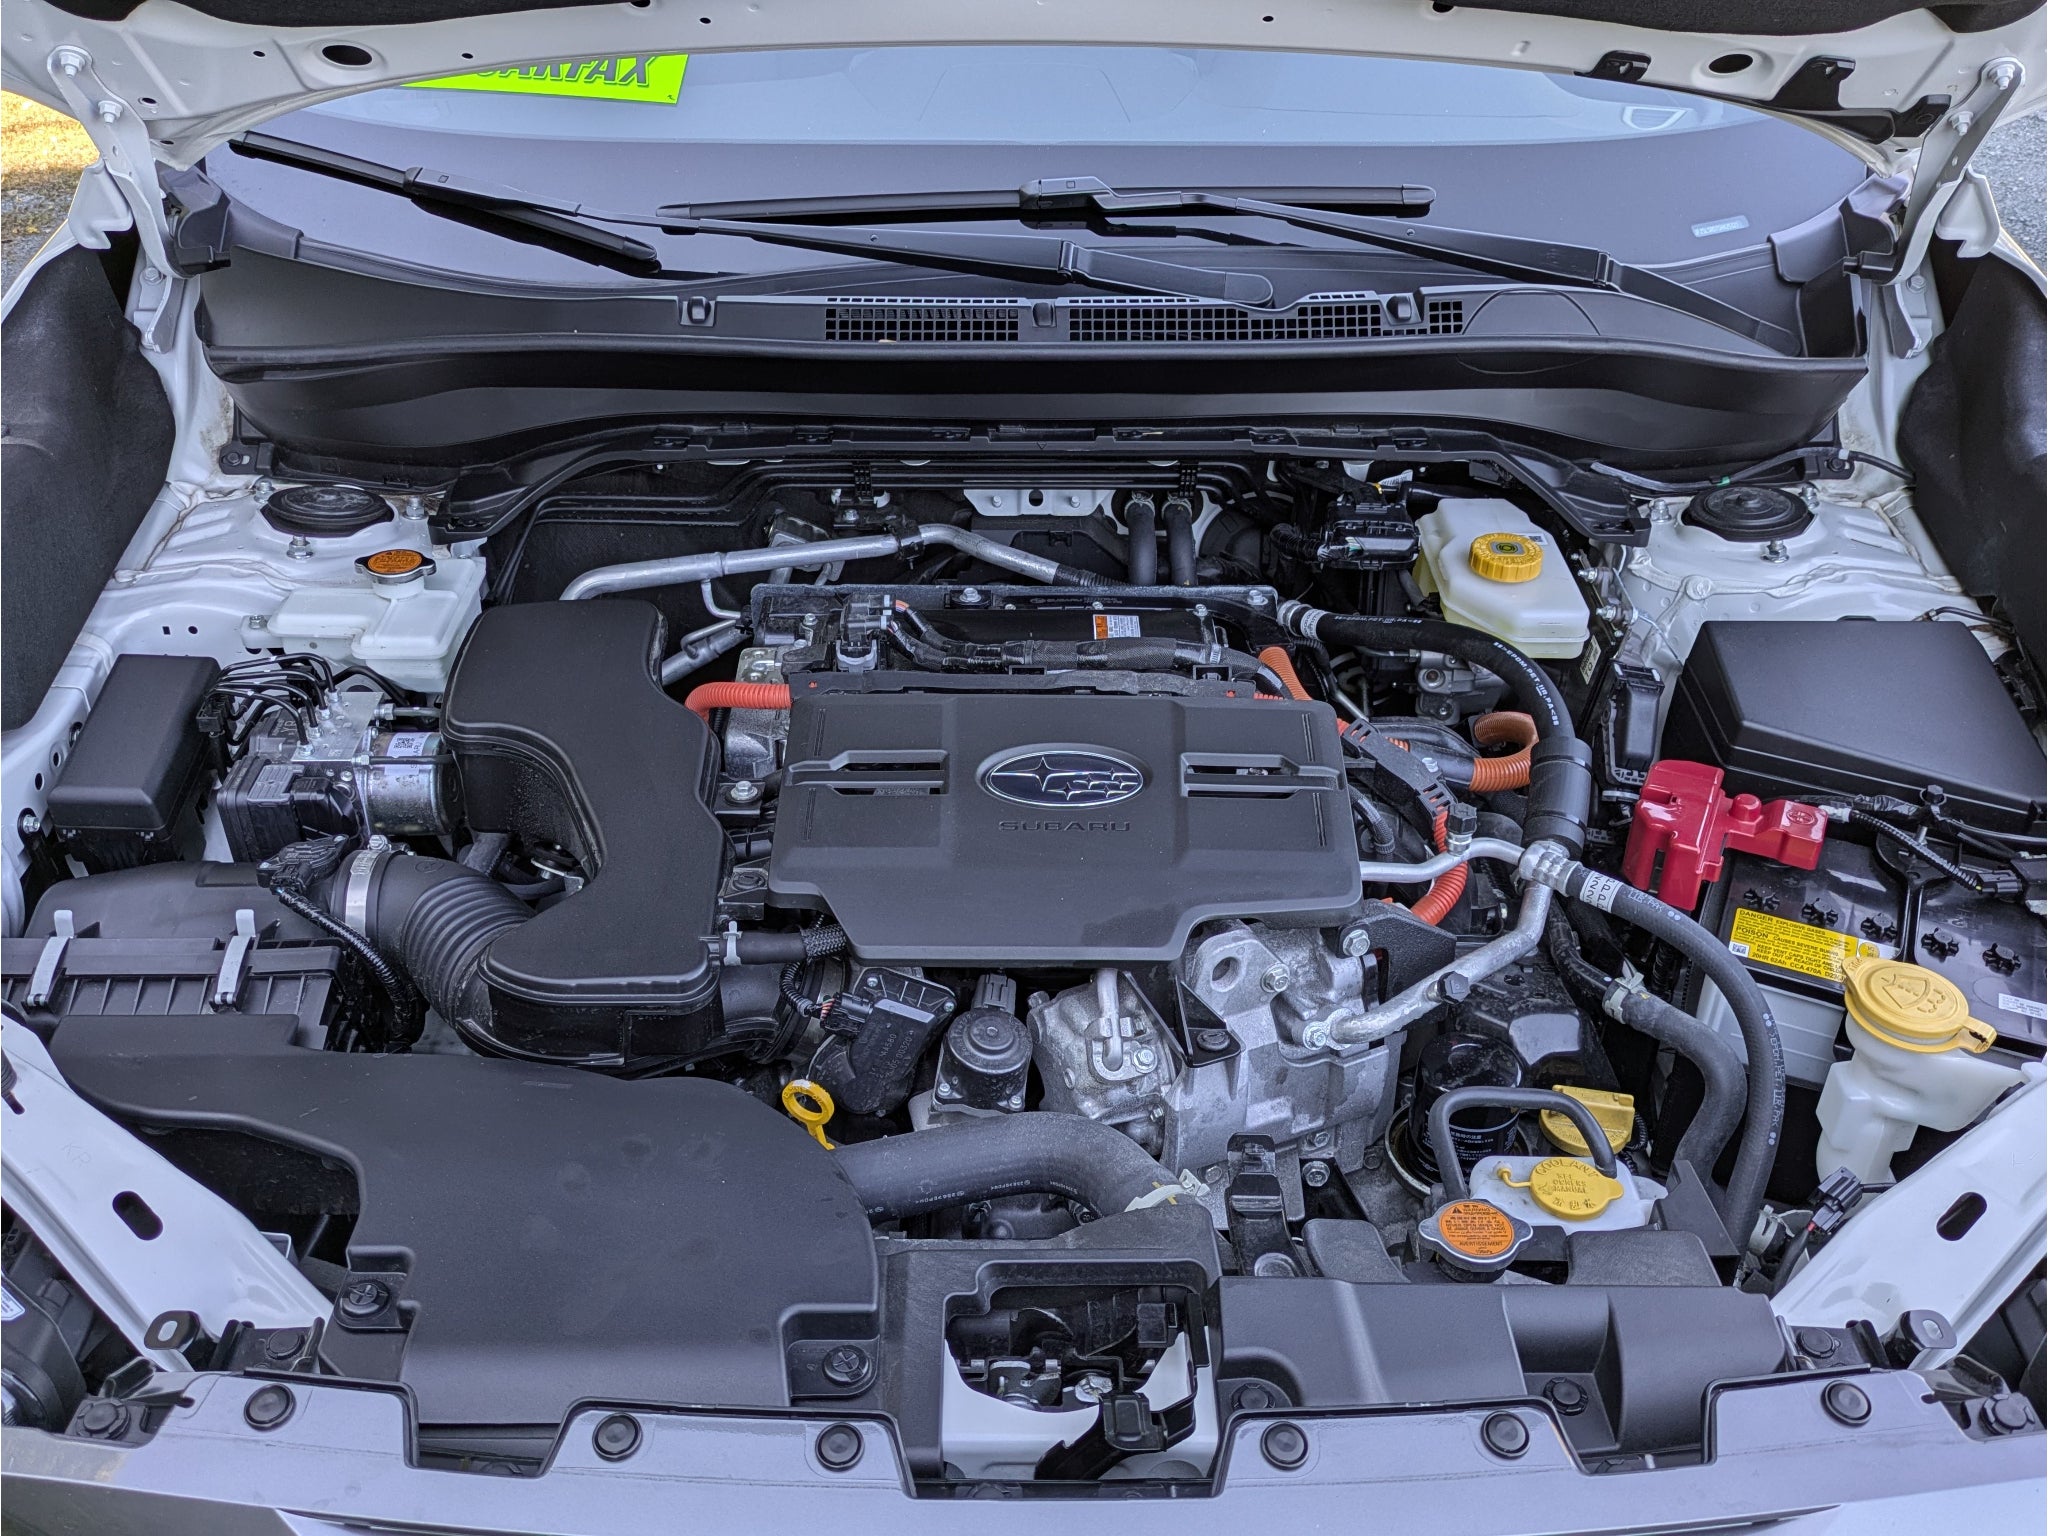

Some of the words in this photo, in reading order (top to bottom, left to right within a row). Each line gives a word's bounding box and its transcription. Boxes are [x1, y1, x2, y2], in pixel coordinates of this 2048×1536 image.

[999, 821, 1131, 832] SUBARU
[1740, 910, 1773, 922] DANGER
[1776, 920, 1805, 930] EXPLOSIVE
[1736, 926, 1768, 938] POISON
[1773, 936, 1795, 945] CAUSES
[1796, 942, 1818, 951] SEVERE
[1752, 953, 1769, 961] 20HR
[1789, 962, 1804, 970] CCA
[1805, 967, 1822, 975] 470A
[1793, 958, 1812, 966] REACH
[1535, 1158, 1599, 1177] COOLANT
